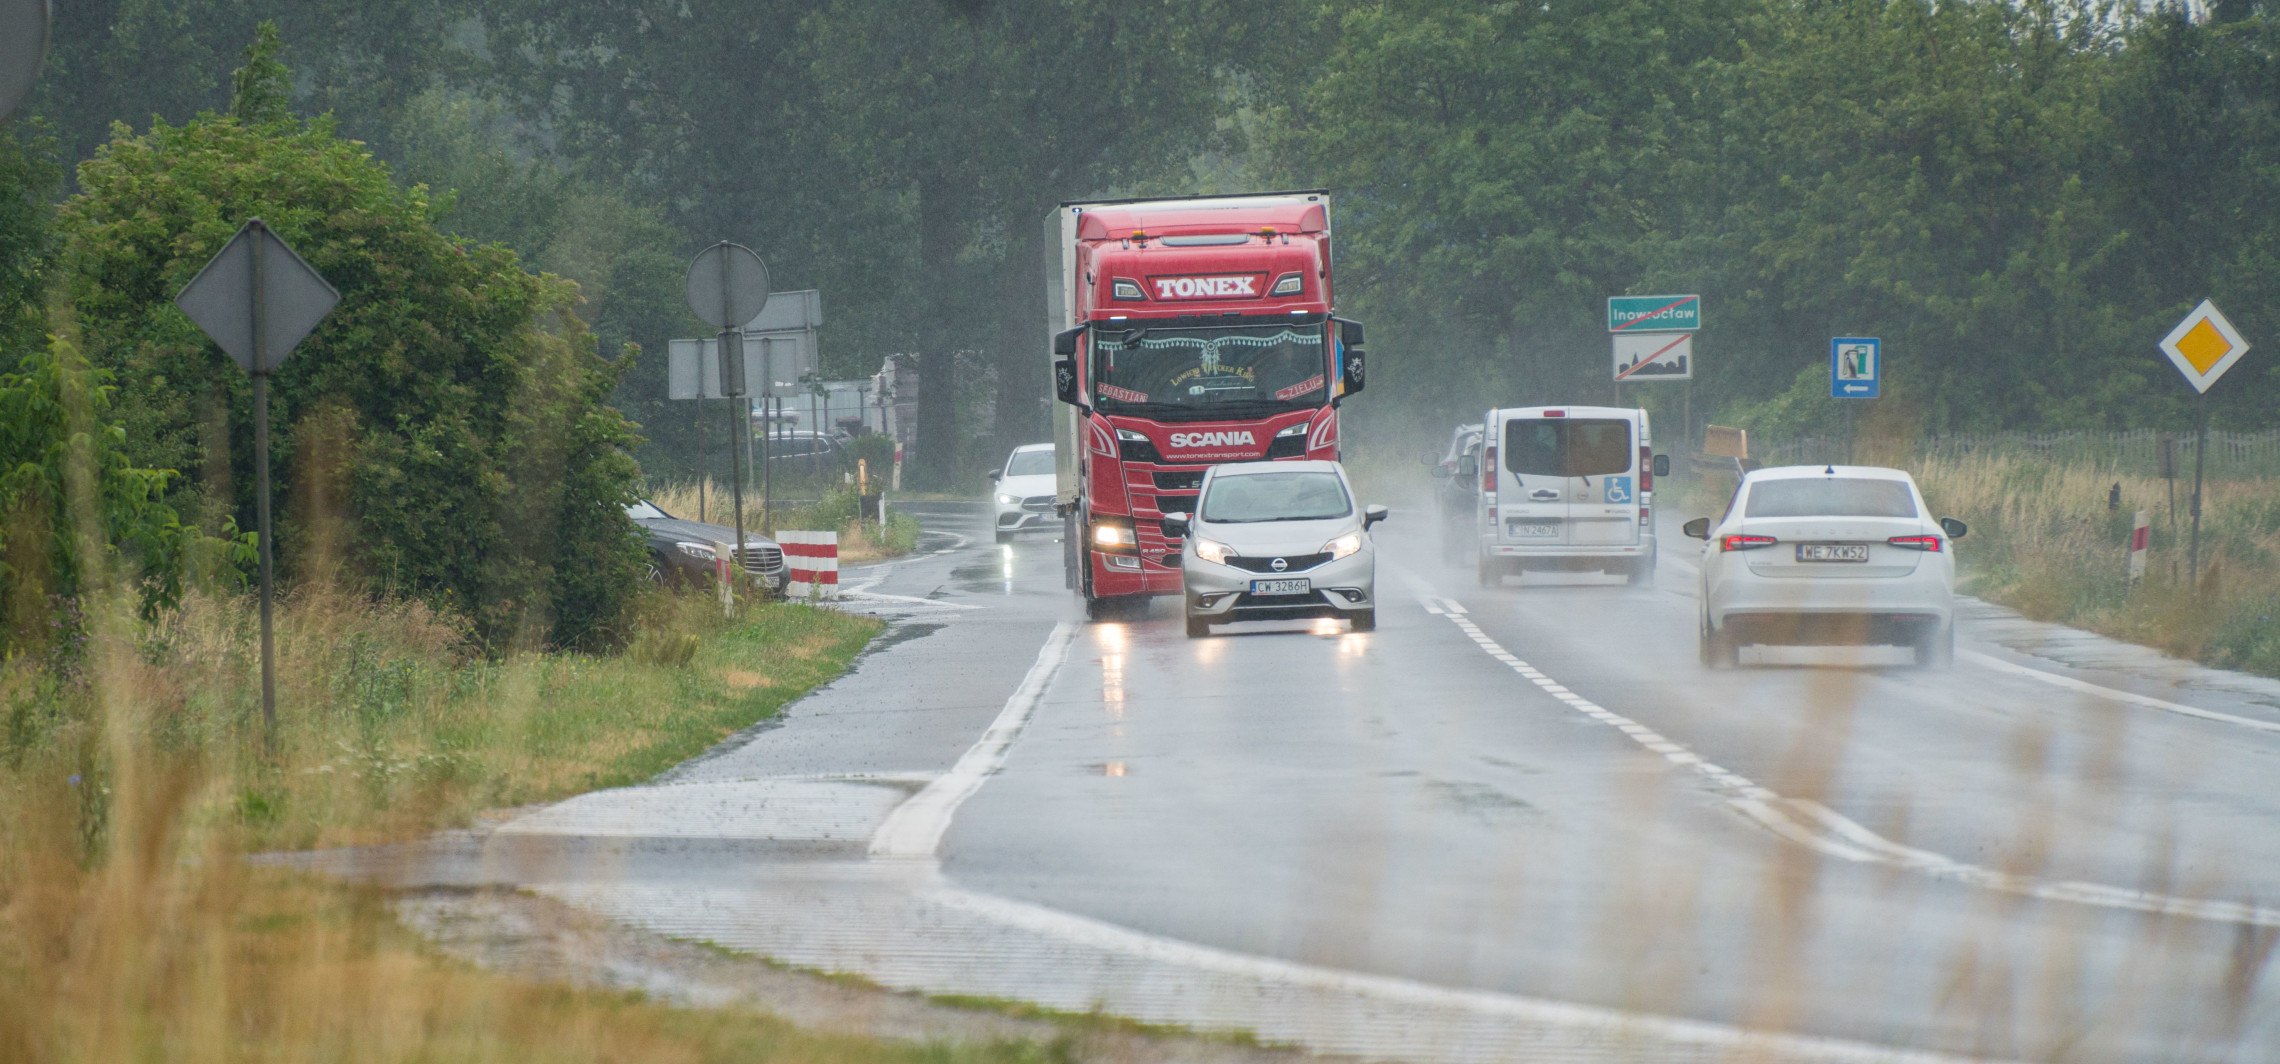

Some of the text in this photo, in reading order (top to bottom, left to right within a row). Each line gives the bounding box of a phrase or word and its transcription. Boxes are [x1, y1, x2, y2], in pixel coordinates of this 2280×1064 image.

[1156, 276, 1255, 297] TONEX
[1098, 384, 1147, 403] SEBASTIAN
[1288, 380, 1317, 397] ZIELU
[1170, 431, 1256, 448] SCANIA
[1166, 451, 1260, 459] www.tonextransport.com
[1805, 546, 1865, 559] WE 7KW52
[1258, 580, 1307, 592] CW 3286H
